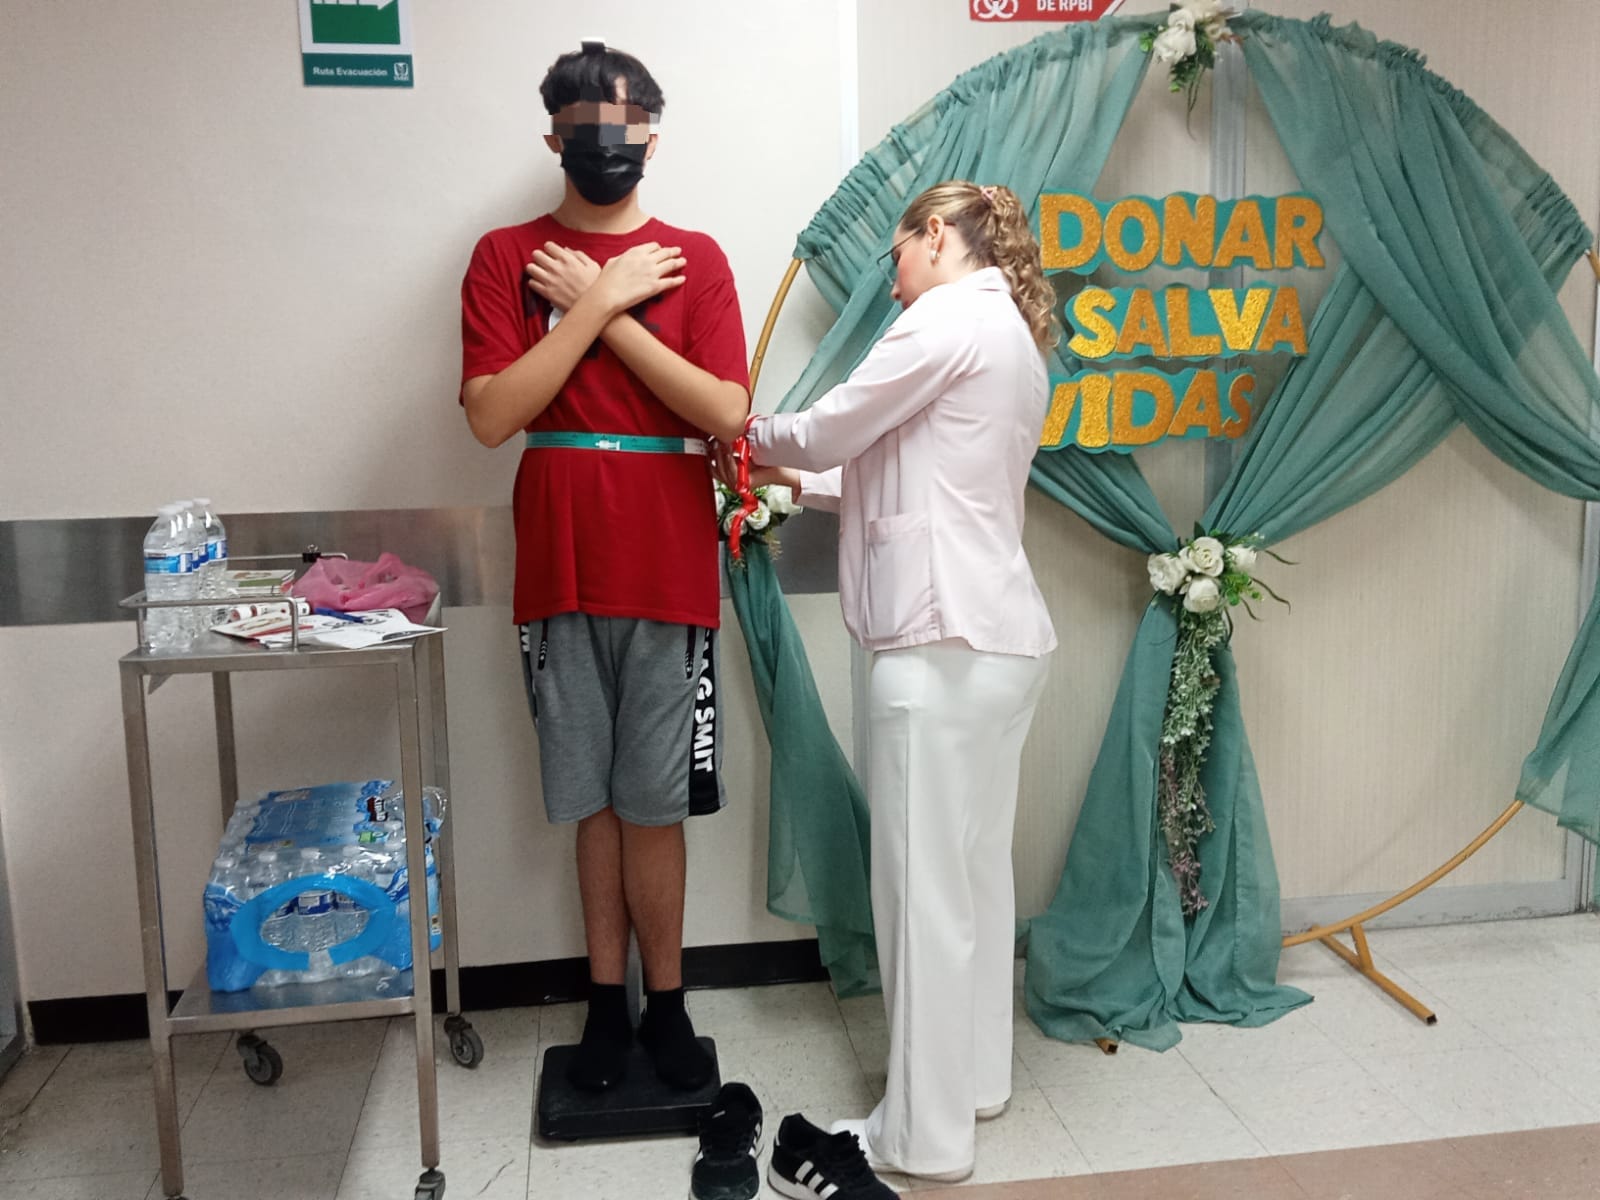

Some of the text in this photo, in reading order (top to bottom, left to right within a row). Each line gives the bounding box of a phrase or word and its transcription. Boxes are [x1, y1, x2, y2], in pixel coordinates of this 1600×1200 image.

[1037, 0, 1093, 11] DE RPBI
[313, 66, 388, 76] Ruta Evacuación
[1039, 194, 1325, 271] DONAR
[1068, 286, 1309, 359] SALVA
